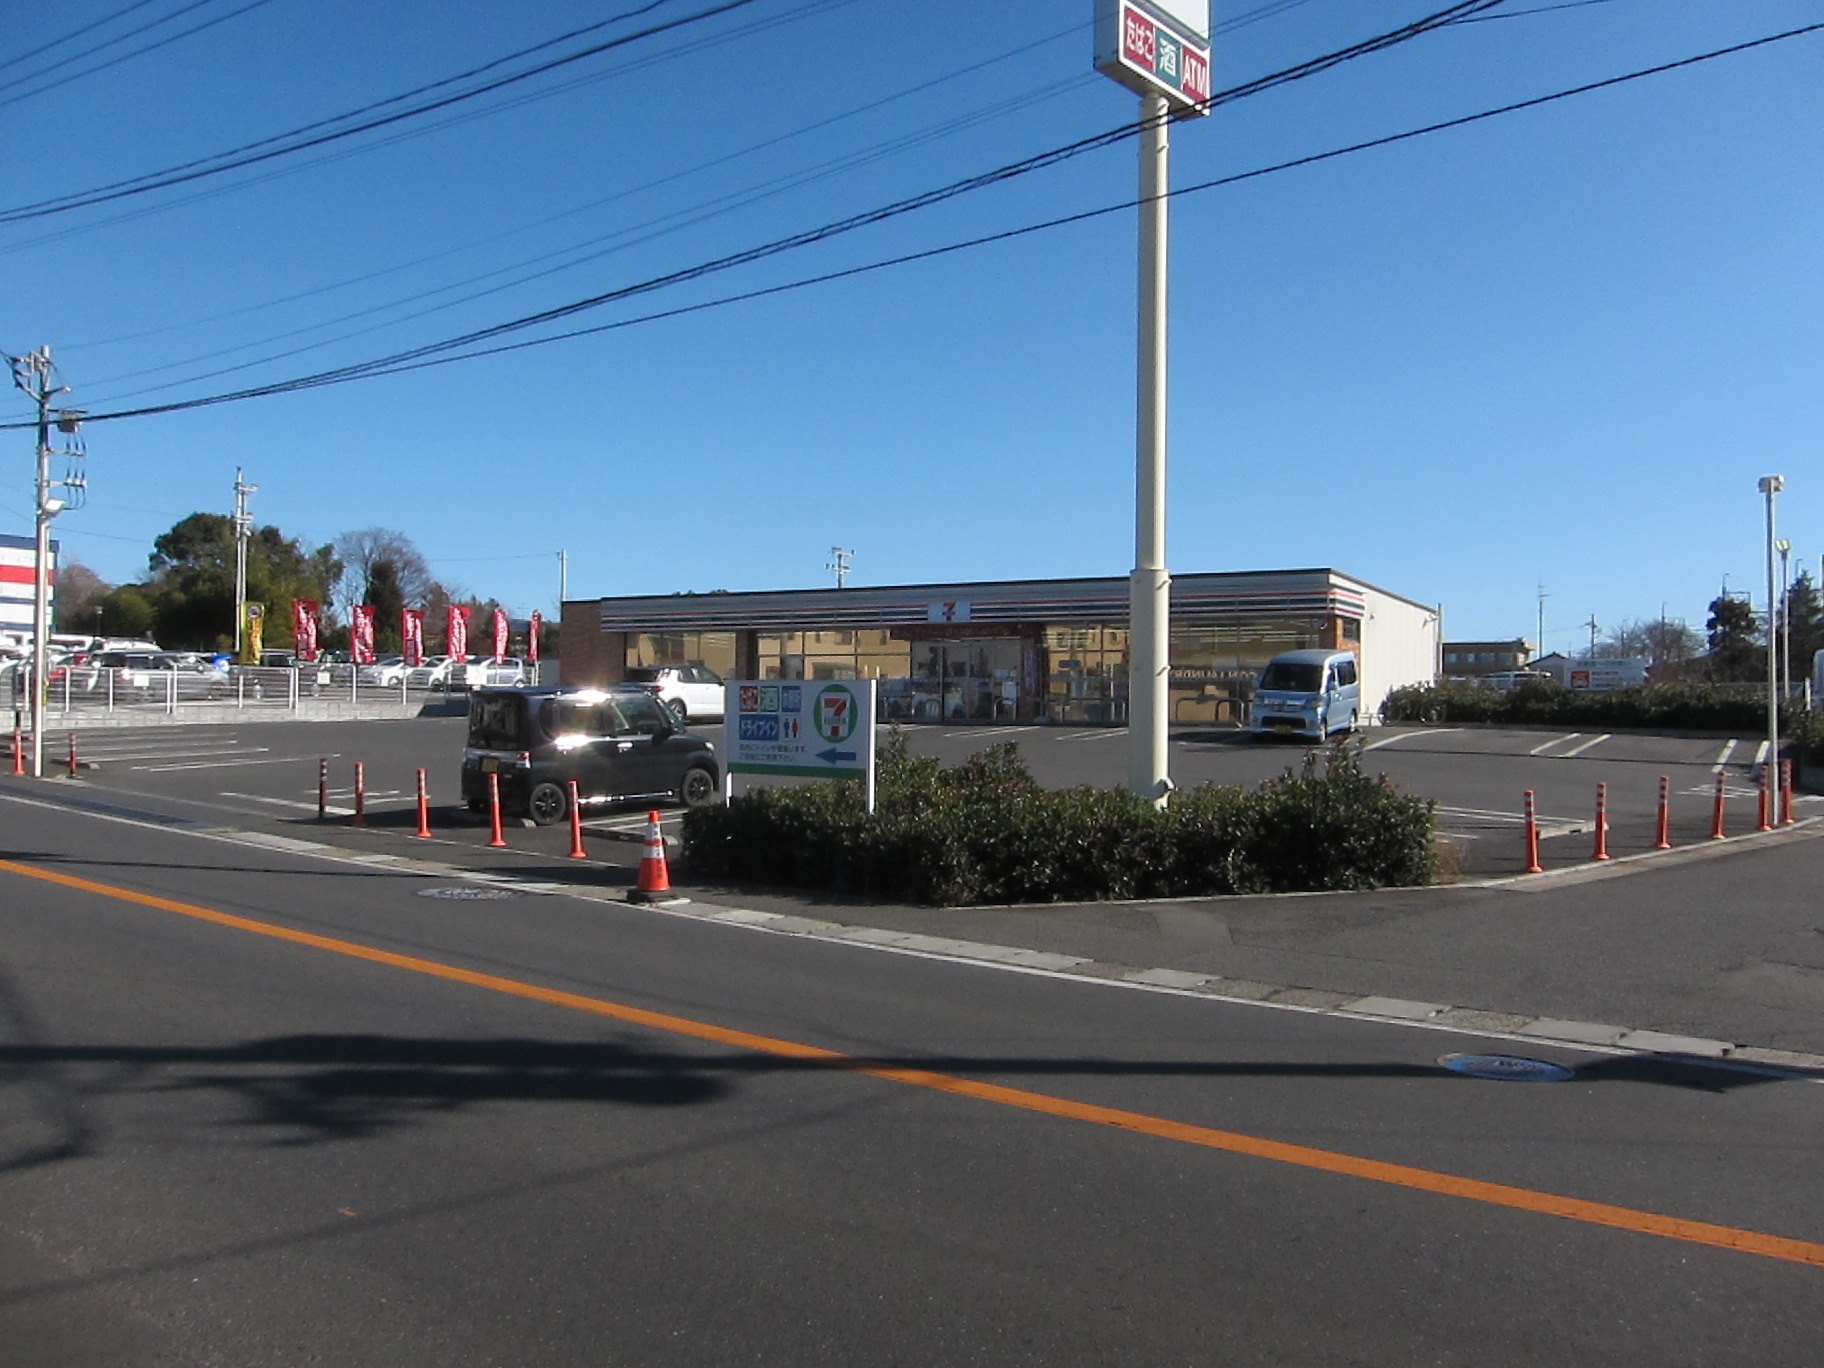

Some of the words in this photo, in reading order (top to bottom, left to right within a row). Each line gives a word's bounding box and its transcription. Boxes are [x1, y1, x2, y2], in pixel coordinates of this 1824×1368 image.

[1126, 17, 1153, 61] たばこ
[1160, 38, 1176, 77] 酒
[1182, 55, 1207, 98] ATM
